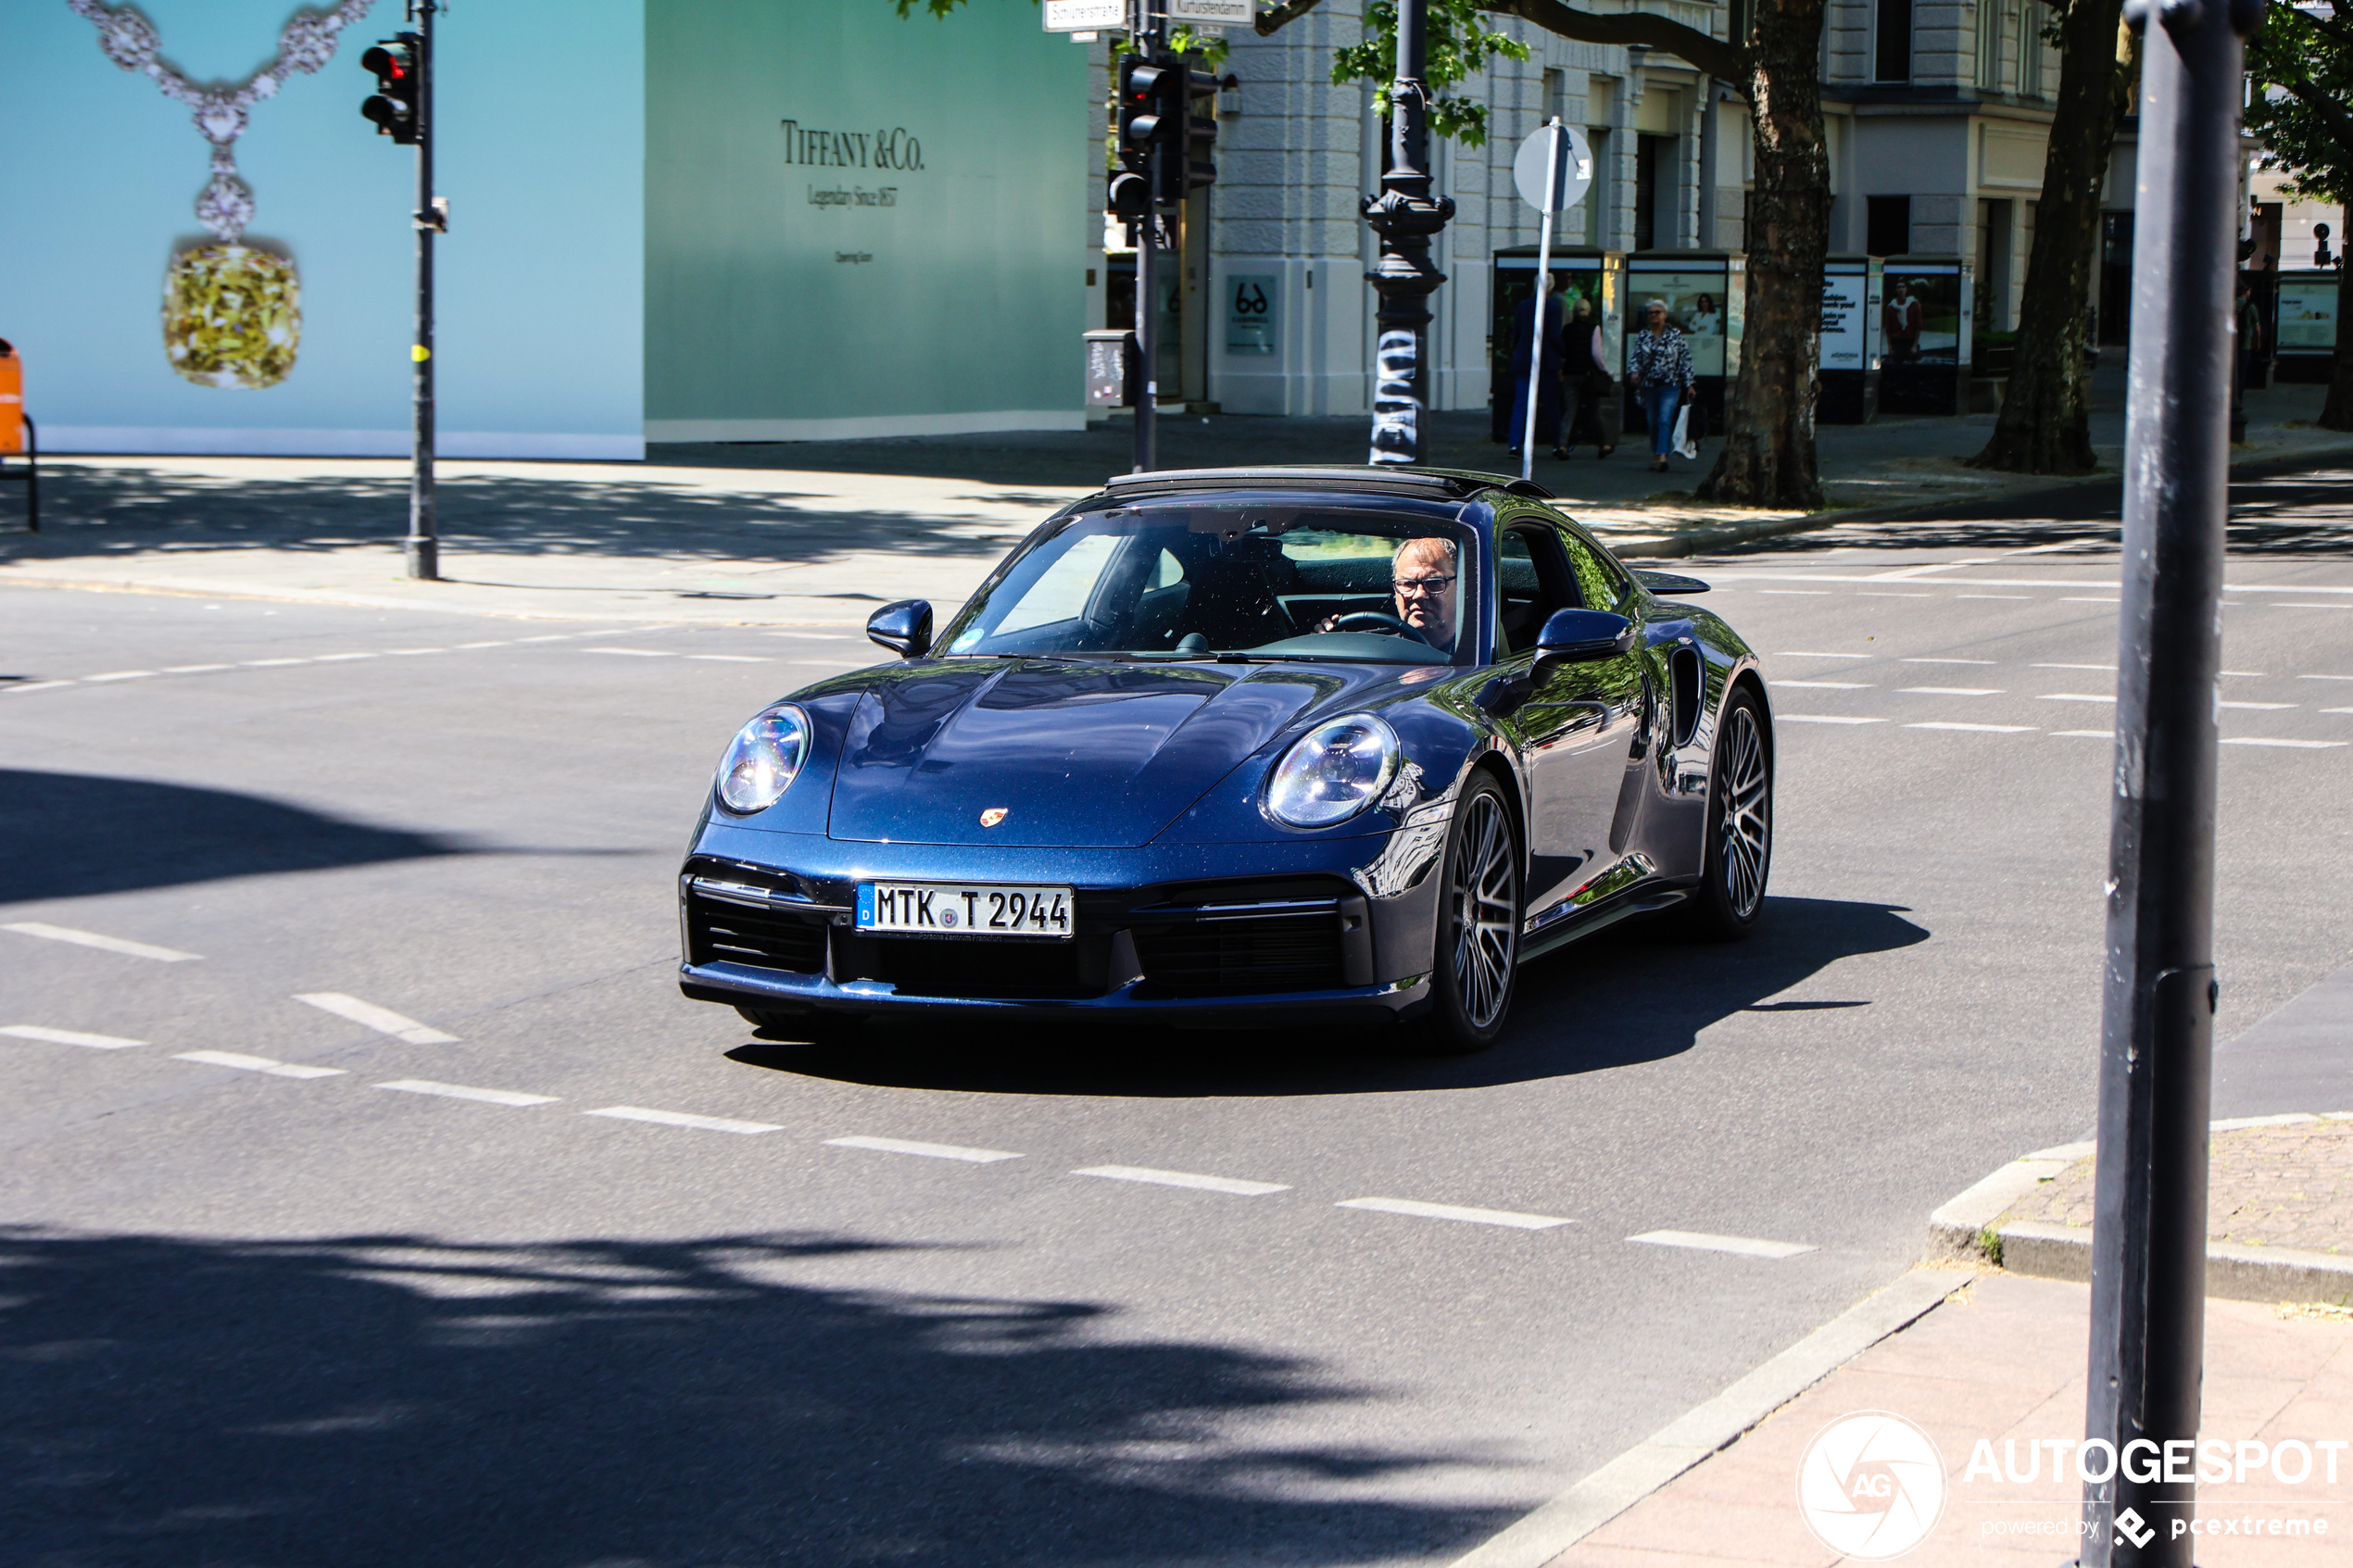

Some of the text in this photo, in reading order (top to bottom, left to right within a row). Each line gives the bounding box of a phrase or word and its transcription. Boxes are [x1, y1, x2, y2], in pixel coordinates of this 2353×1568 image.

[877, 888, 1067, 928] MTK T 2944
[862, 909, 870, 921] D
[945, 933, 971, 941] Zentrum
[972, 934, 1002, 942] Frankfurt
